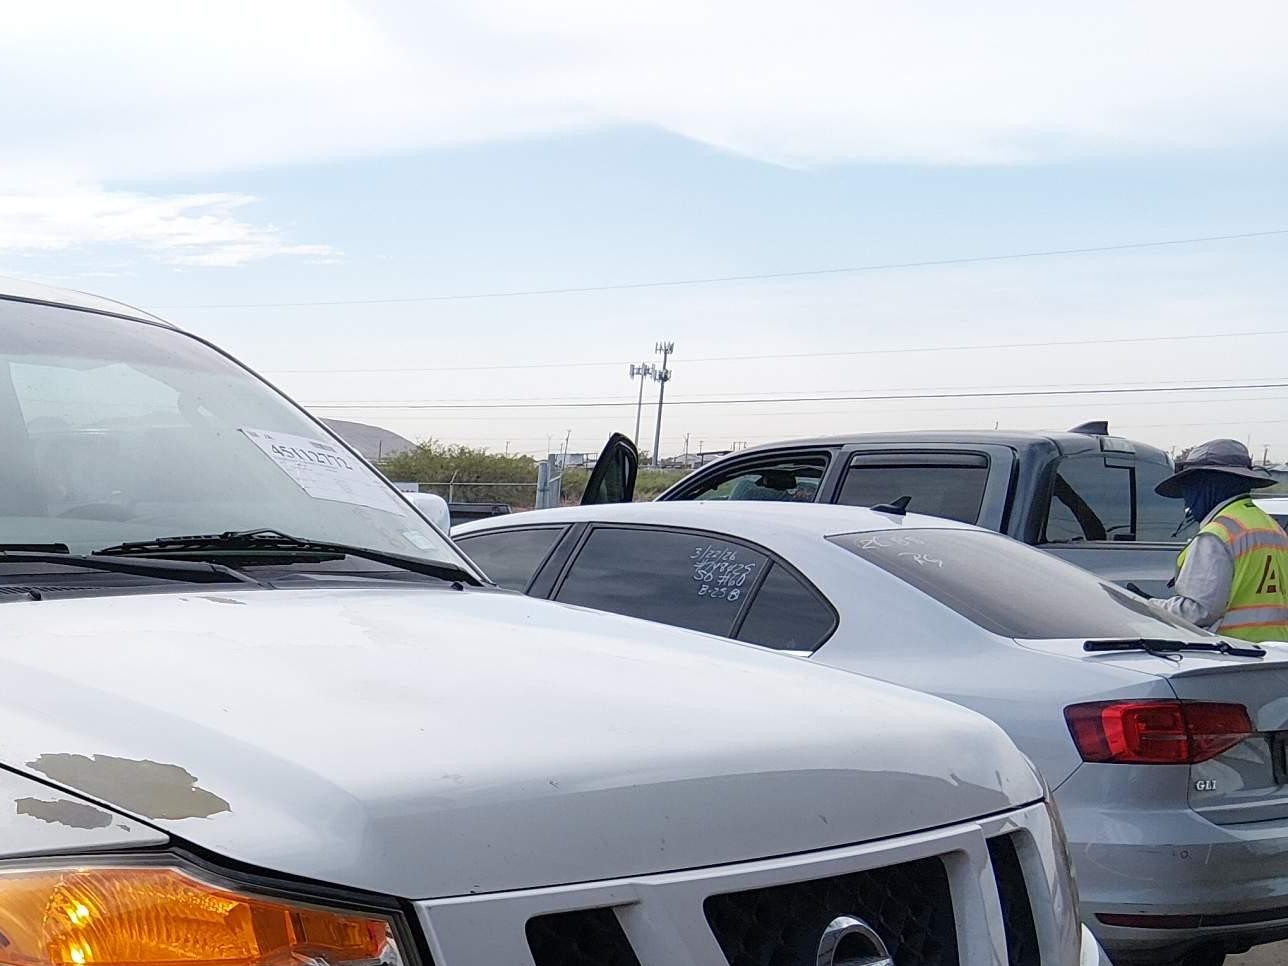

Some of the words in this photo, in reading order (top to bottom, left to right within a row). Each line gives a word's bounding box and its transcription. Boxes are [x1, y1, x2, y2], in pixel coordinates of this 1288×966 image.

[271, 444, 353, 470] 45112772
[690, 545, 737, 561] 3/22/26
[1195, 780, 1217, 791] GLI
